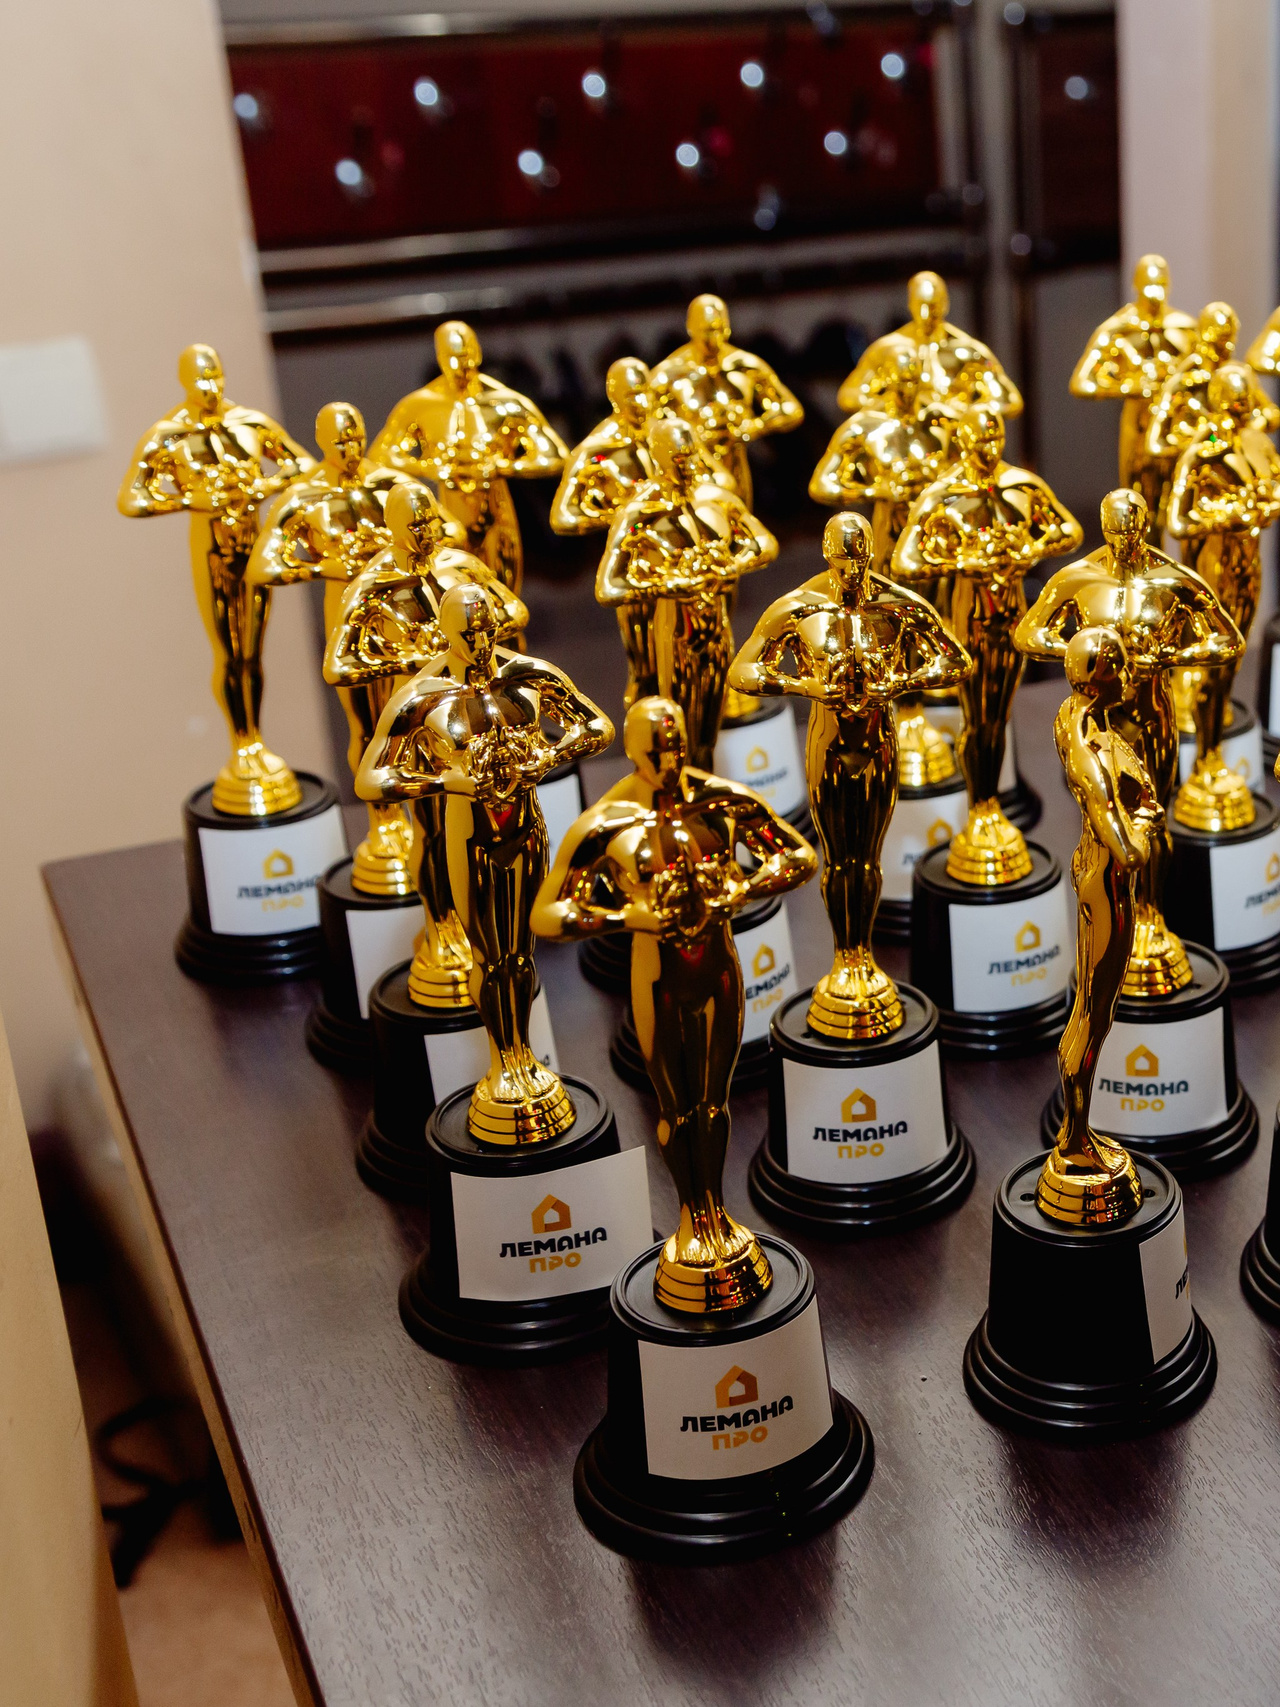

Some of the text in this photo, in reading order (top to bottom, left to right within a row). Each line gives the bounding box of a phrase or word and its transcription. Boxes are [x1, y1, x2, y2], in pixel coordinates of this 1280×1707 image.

[988, 945, 1061, 974] ЛЕМАНА
[746, 963, 790, 999] ЕМАНА
[1011, 967, 1047, 986] ПРО
[1099, 1078, 1190, 1096] ЛЕМАНА
[1120, 1098, 1165, 1112] ПРО
[813, 1120, 908, 1142] ЛЕМАНА
[837, 1143, 885, 1159] ПРО
[499, 1226, 608, 1258] ЛЕМАНА
[529, 1252, 582, 1273] ПРО
[680, 1395, 794, 1432] ЛЕМАНА
[711, 1425, 768, 1451] ПРО
